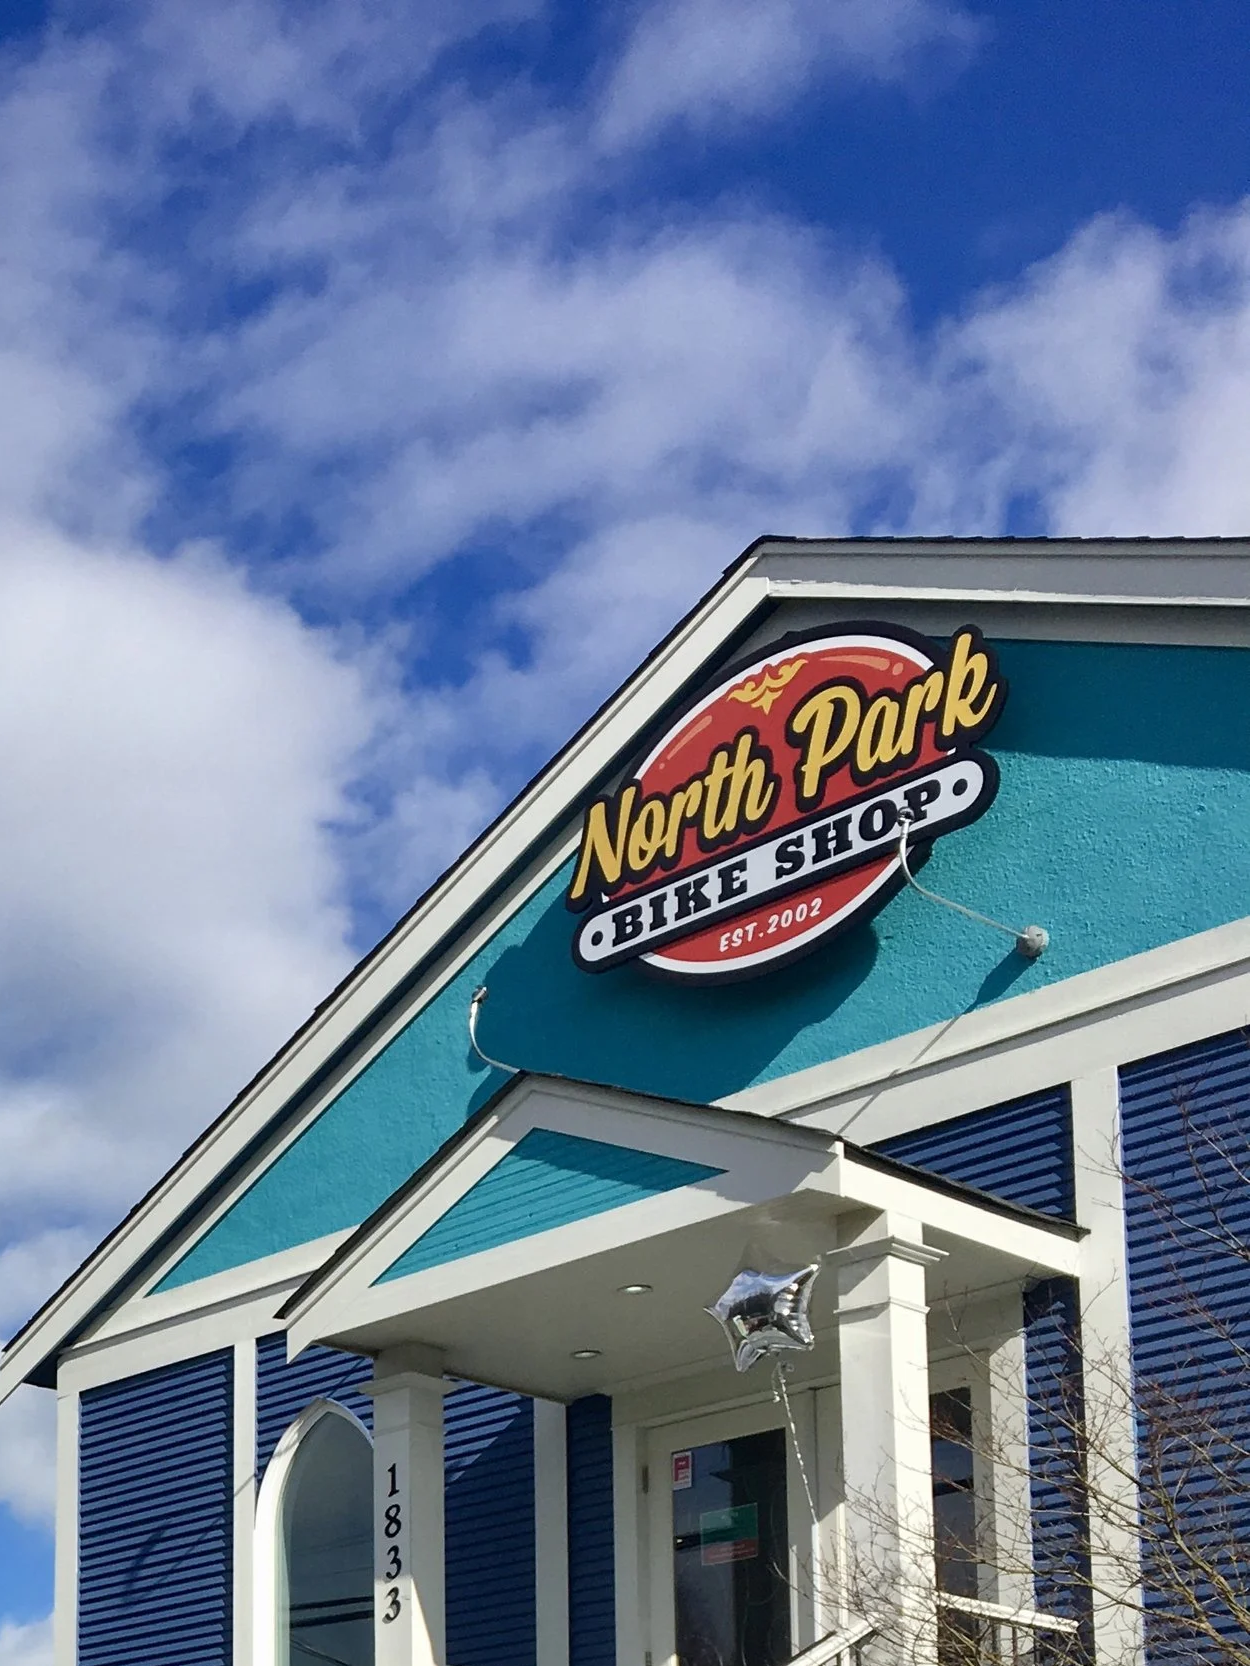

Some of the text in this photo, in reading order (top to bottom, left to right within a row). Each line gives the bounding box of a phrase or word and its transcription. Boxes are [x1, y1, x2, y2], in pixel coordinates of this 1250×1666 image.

[572, 633, 996, 899] North Park
[612, 780, 942, 947] BIKE SHOP
[719, 898, 823, 952] EST.2002
[382, 1463, 403, 1624] 1833
